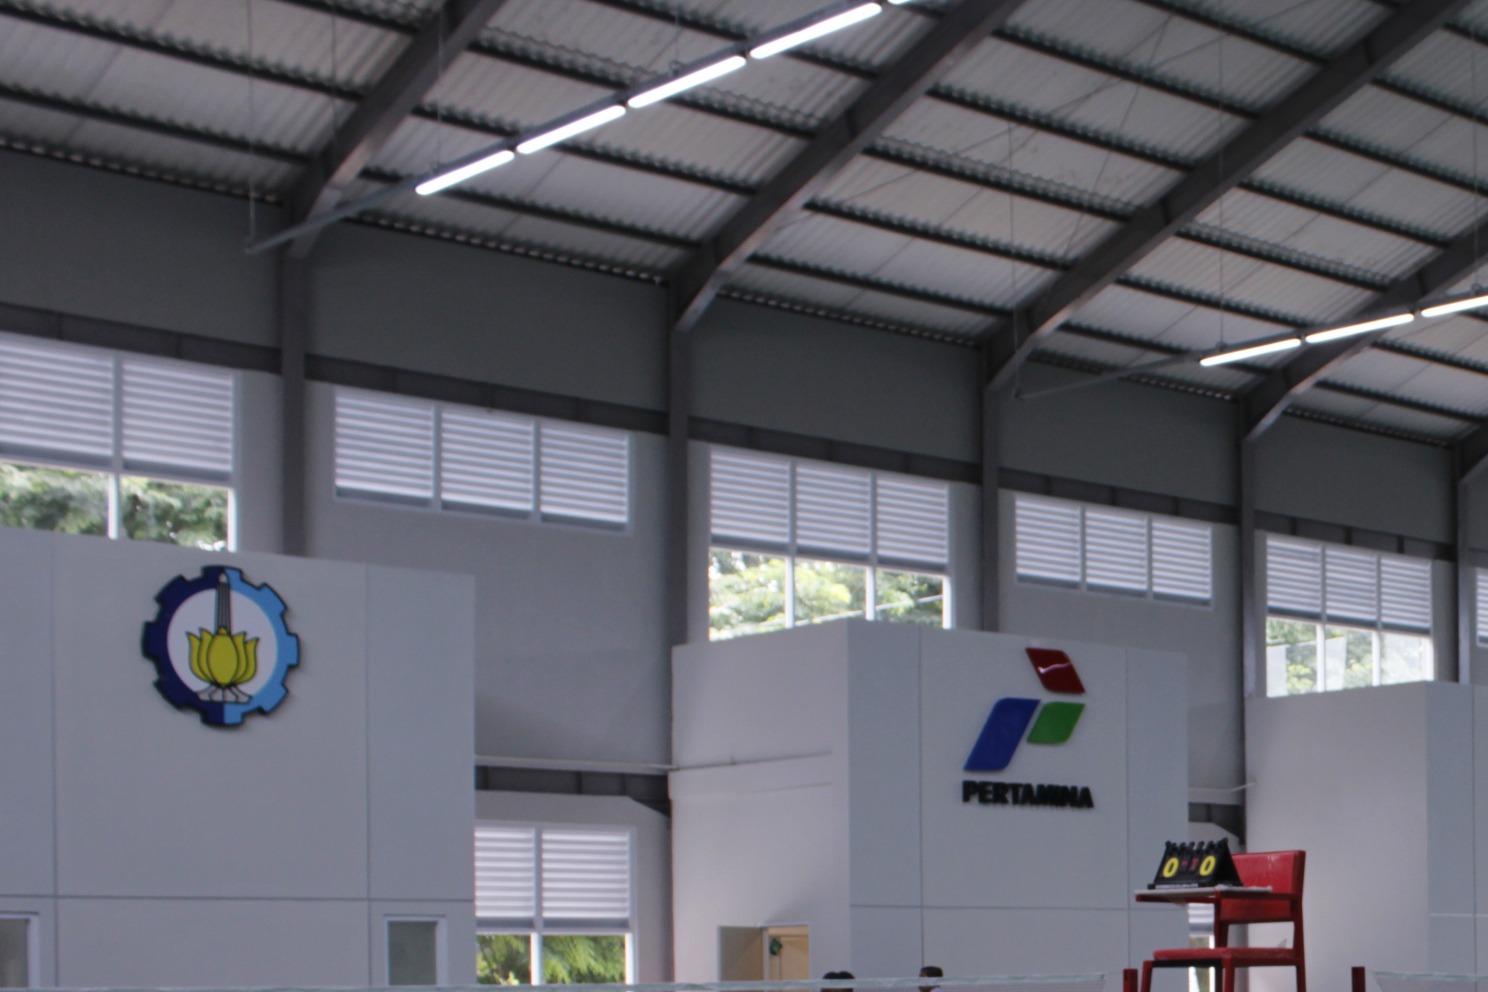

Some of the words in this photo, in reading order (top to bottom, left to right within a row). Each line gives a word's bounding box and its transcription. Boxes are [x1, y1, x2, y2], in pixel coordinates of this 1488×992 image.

[962, 780, 1095, 809] PERTAMINA
[1162, 857, 1179, 878] 0
[1199, 855, 1216, 877] 0
